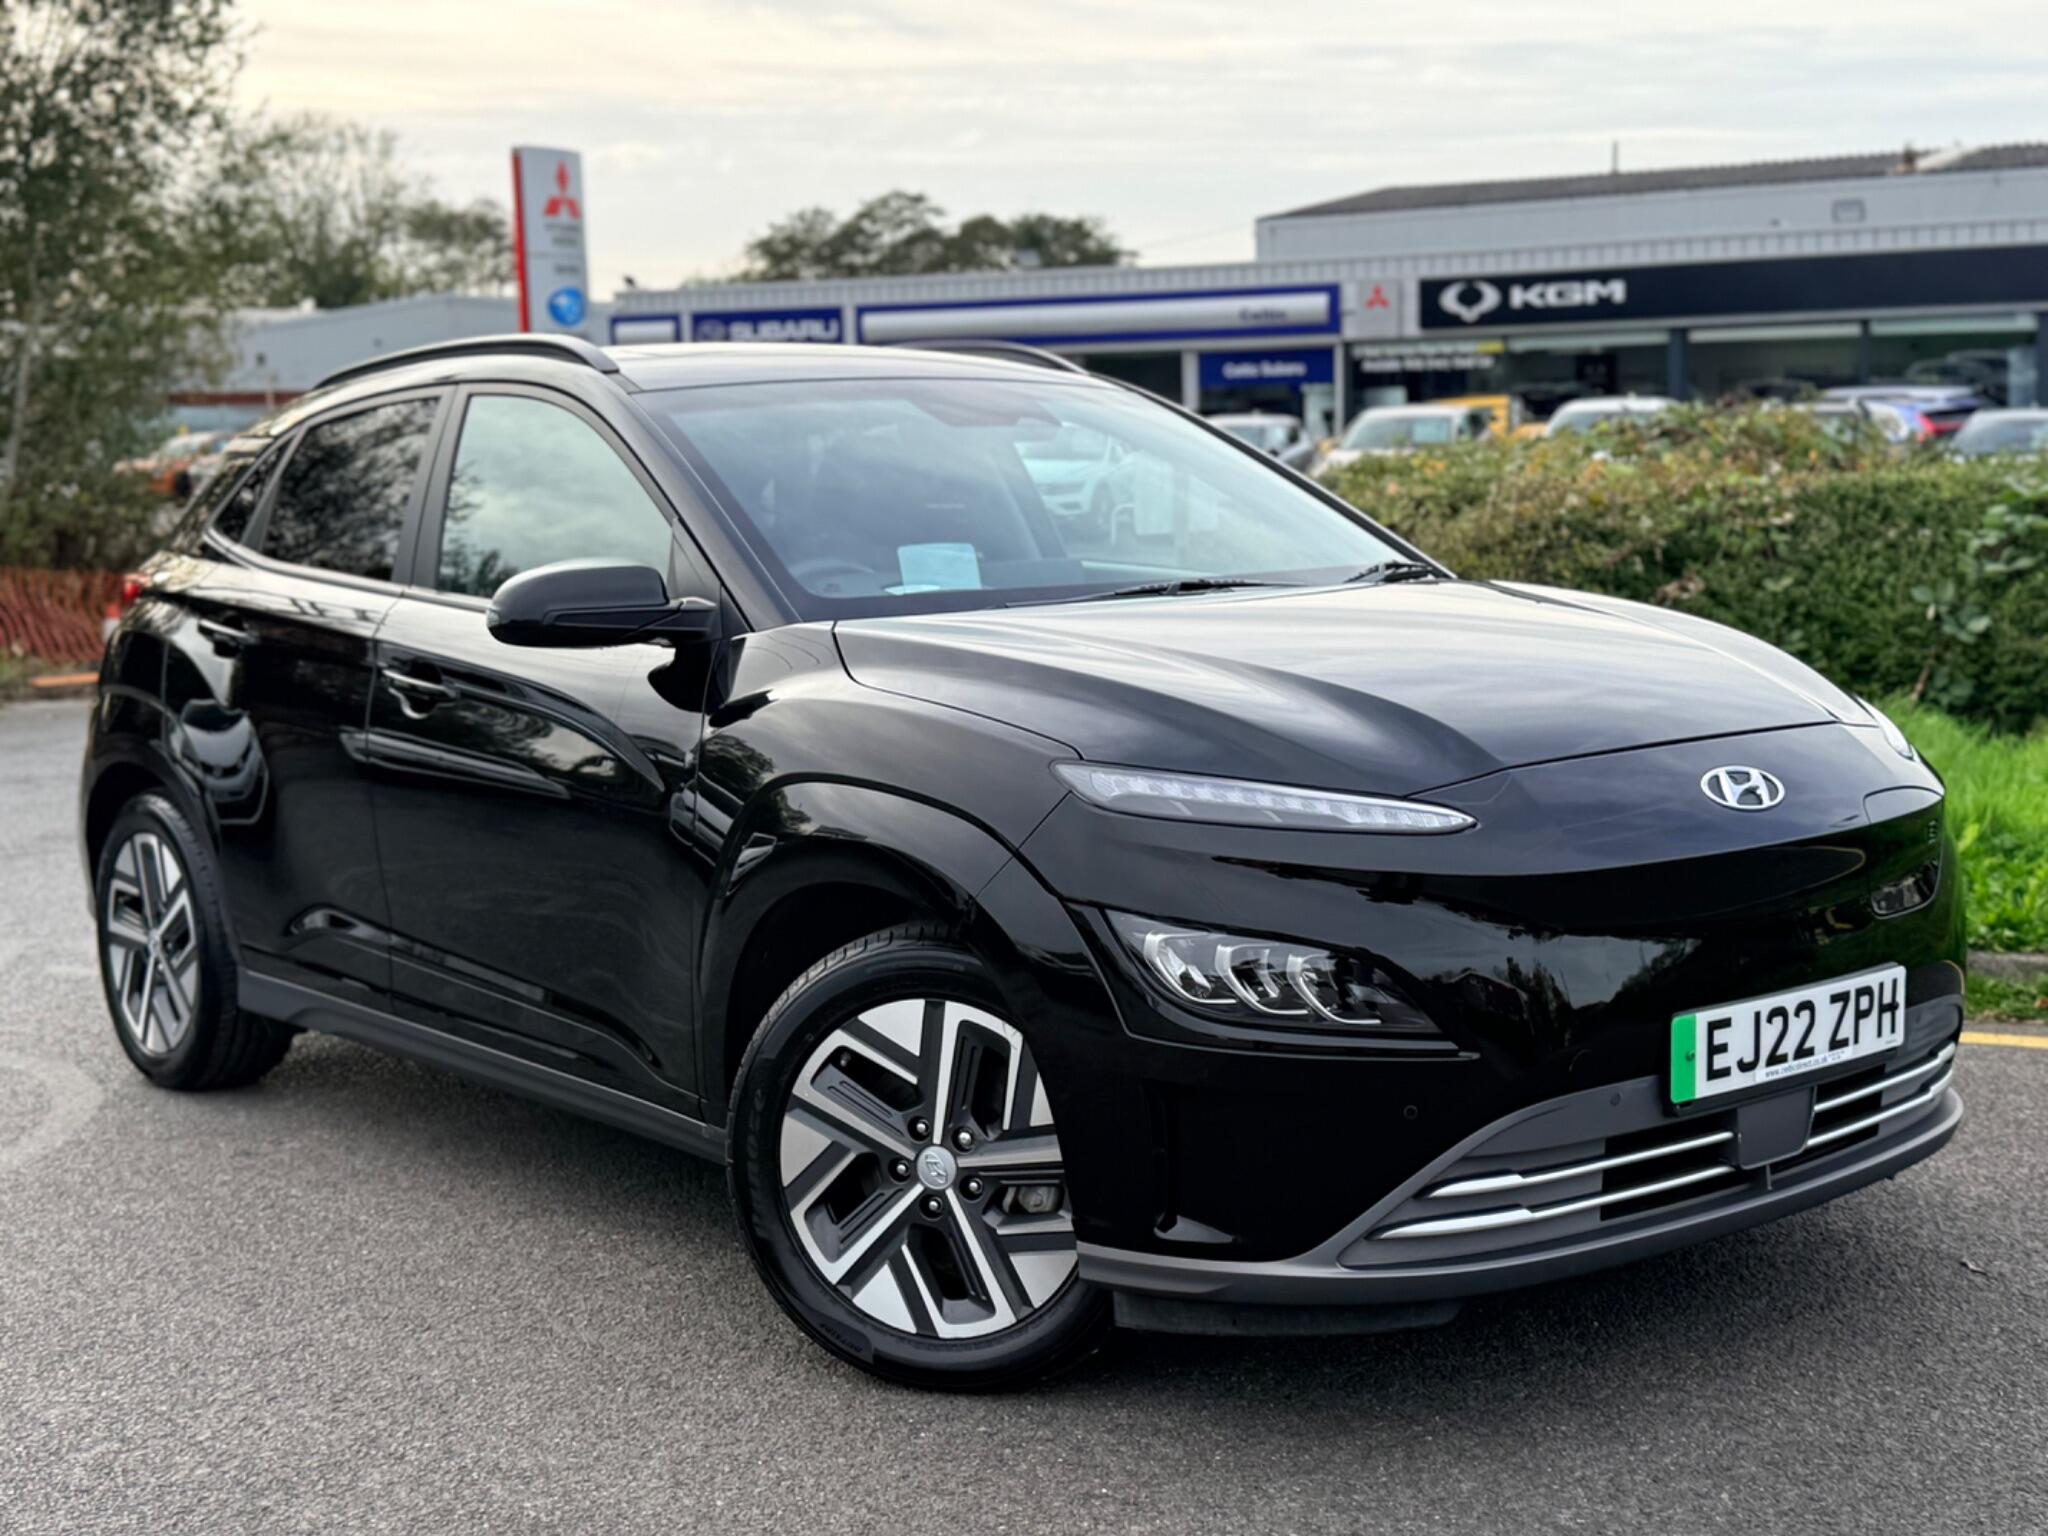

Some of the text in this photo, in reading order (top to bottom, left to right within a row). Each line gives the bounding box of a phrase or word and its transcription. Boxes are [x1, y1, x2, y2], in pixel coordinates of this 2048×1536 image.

[1508, 278, 1627, 310] KGM
[728, 318, 840, 342] SUBARU
[1706, 977, 1899, 1082] EJ22 ZPH
